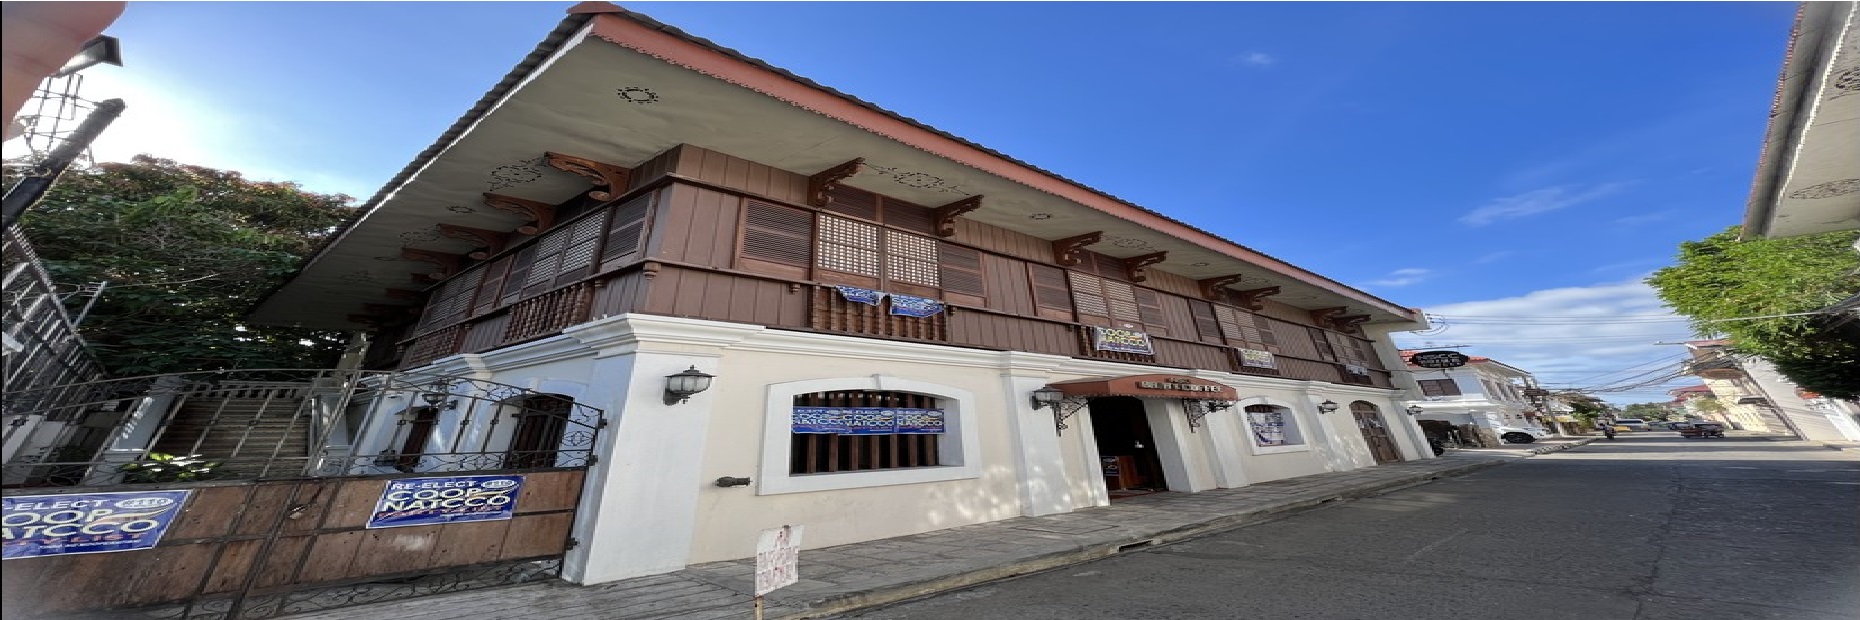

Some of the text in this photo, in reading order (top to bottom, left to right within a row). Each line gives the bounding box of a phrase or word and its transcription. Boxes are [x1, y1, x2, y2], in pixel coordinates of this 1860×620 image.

[391, 480, 476, 490] RE-ELECT
[388, 487, 482, 502] COOP
[2, 499, 109, 511] -ELECT
[382, 495, 510, 512] NATCCO
[2, 508, 113, 527] OOP
